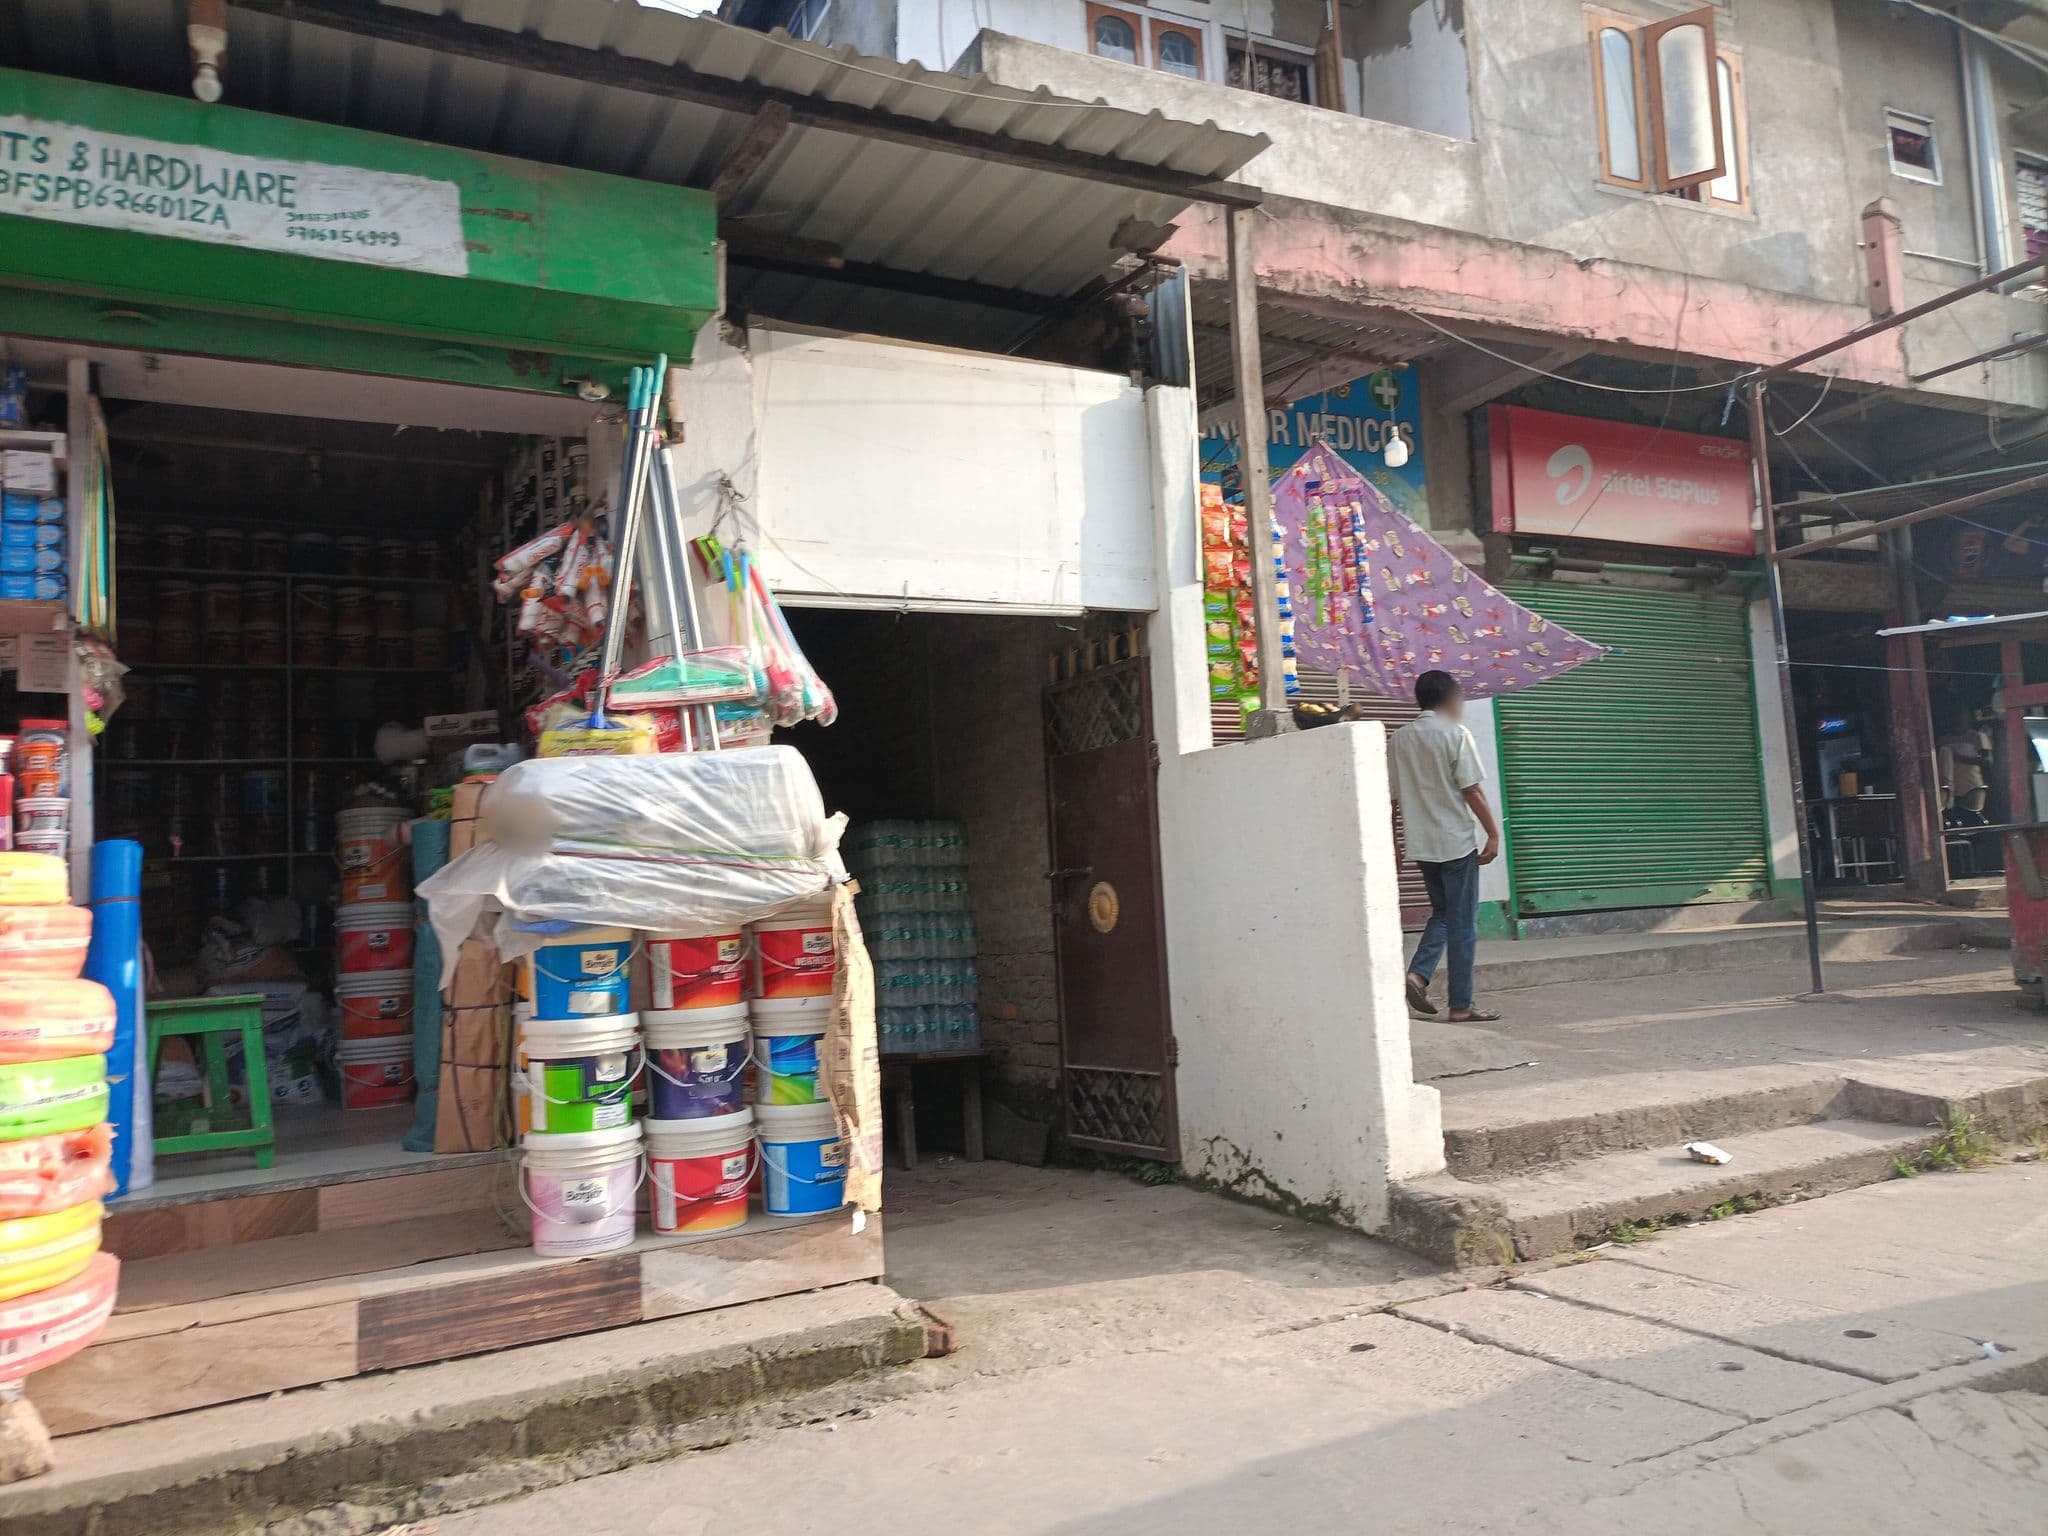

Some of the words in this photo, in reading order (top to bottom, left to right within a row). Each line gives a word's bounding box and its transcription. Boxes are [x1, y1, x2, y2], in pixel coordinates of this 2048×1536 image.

[68, 141, 89, 171] &
[101, 148, 297, 208] HARDWARE
[1602, 469, 1652, 497] airtel
[566, 1188, 604, 1203] Berger
